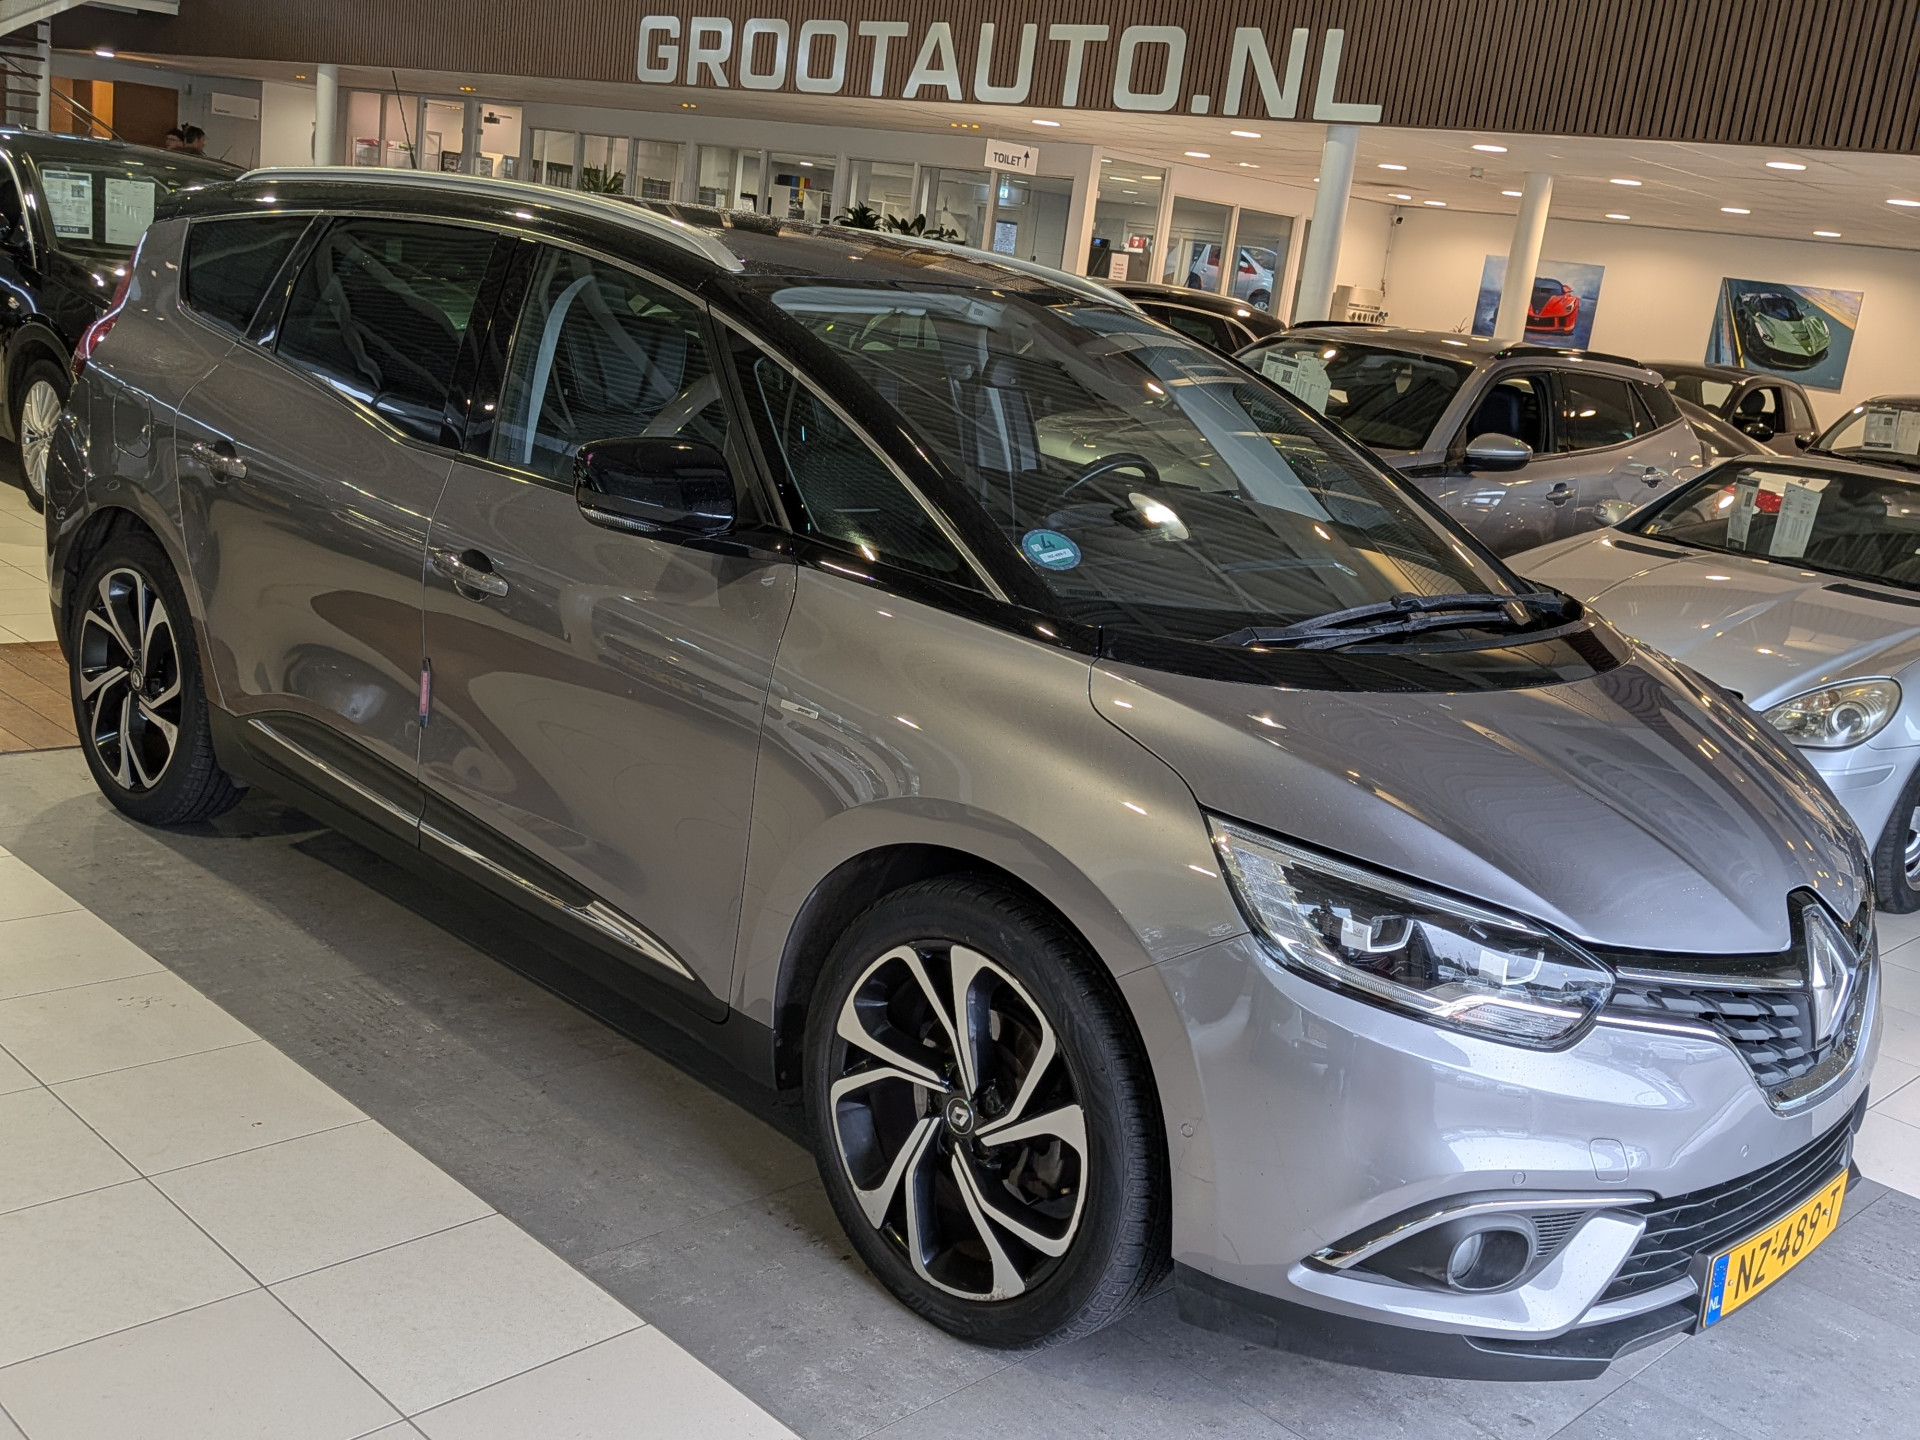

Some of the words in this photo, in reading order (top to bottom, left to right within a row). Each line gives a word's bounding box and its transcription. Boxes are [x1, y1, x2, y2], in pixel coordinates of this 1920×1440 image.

[636, 15, 1382, 123] GROOTAUTO.NL
[993, 152, 1022, 167] TOILET
[1709, 1296, 1720, 1313] NL
